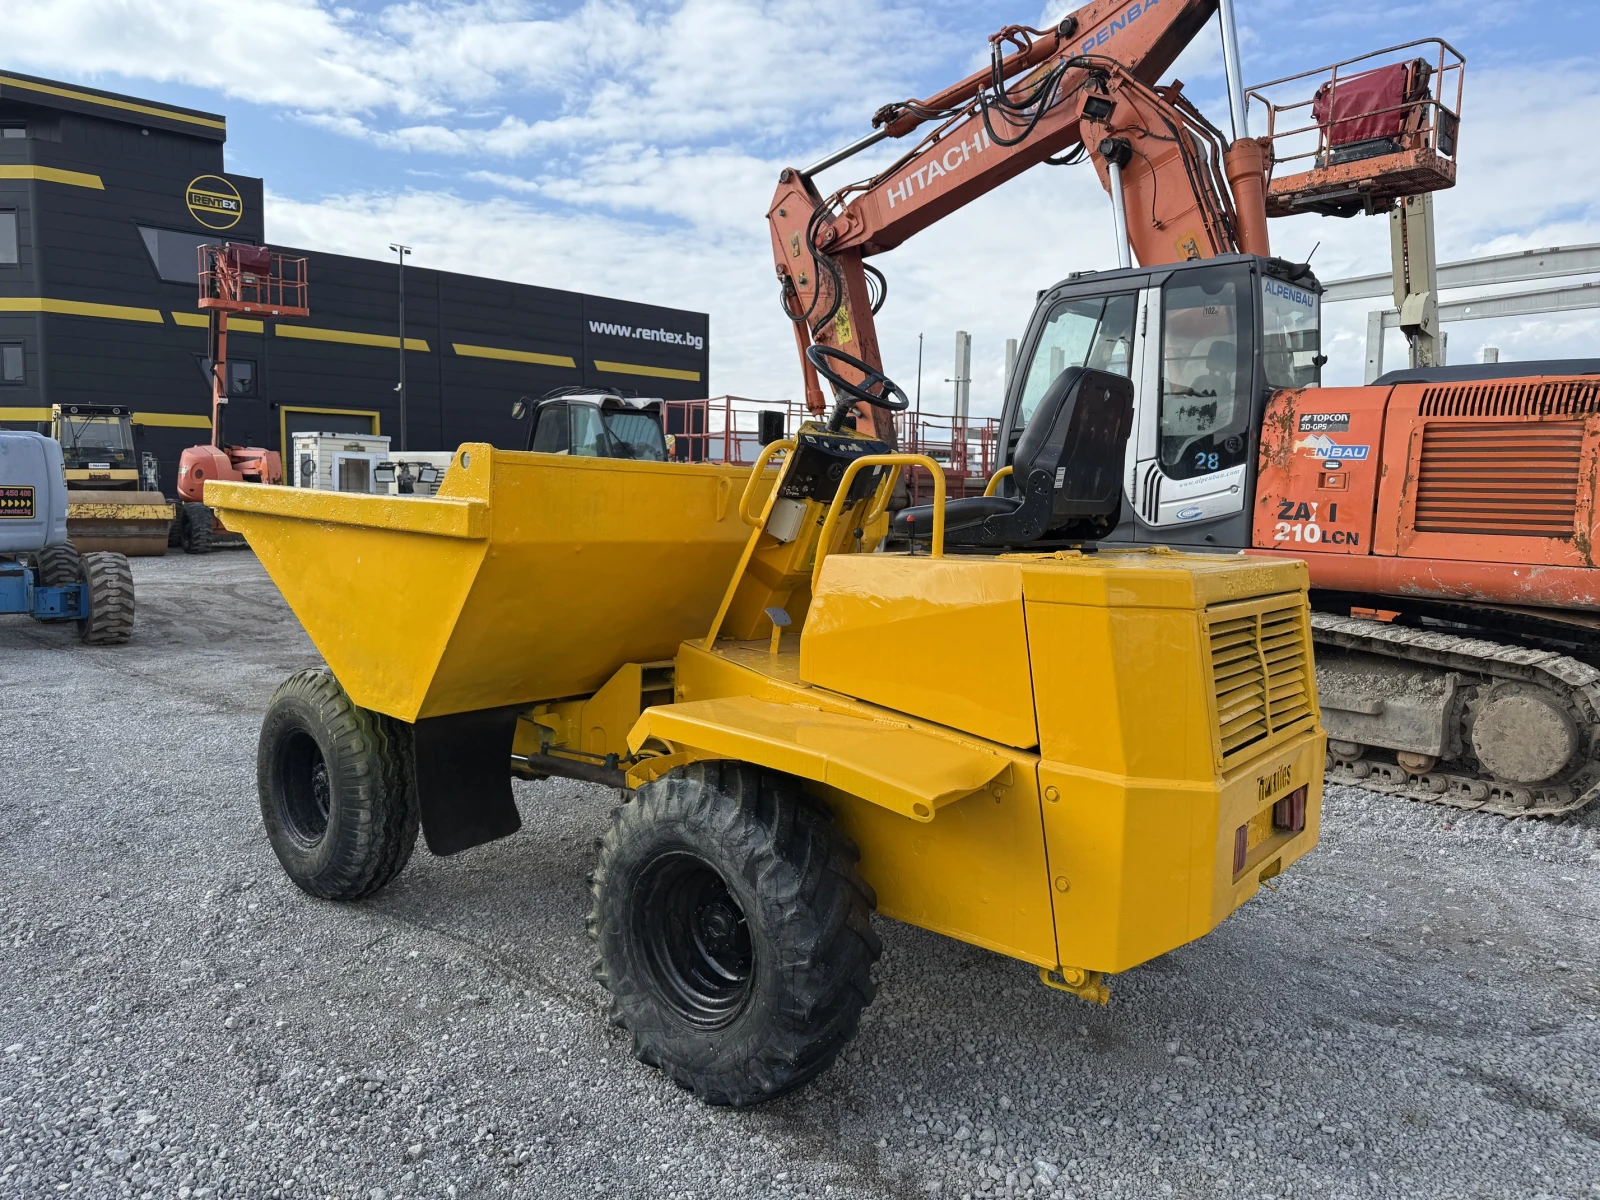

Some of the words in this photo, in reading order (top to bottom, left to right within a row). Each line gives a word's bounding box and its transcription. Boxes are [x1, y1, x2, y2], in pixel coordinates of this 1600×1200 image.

[886, 127, 991, 209] HITACHI
[192, 193, 237, 210] RENTEX
[1264, 281, 1314, 308] ALPENBAU
[1204, 306, 1215, 315] 102
[588, 320, 703, 350] www.rentex.bg
[1312, 413, 1348, 422] TOPCON
[1194, 452, 1219, 470] 28
[1179, 469, 1241, 488] www.alpenbau.com
